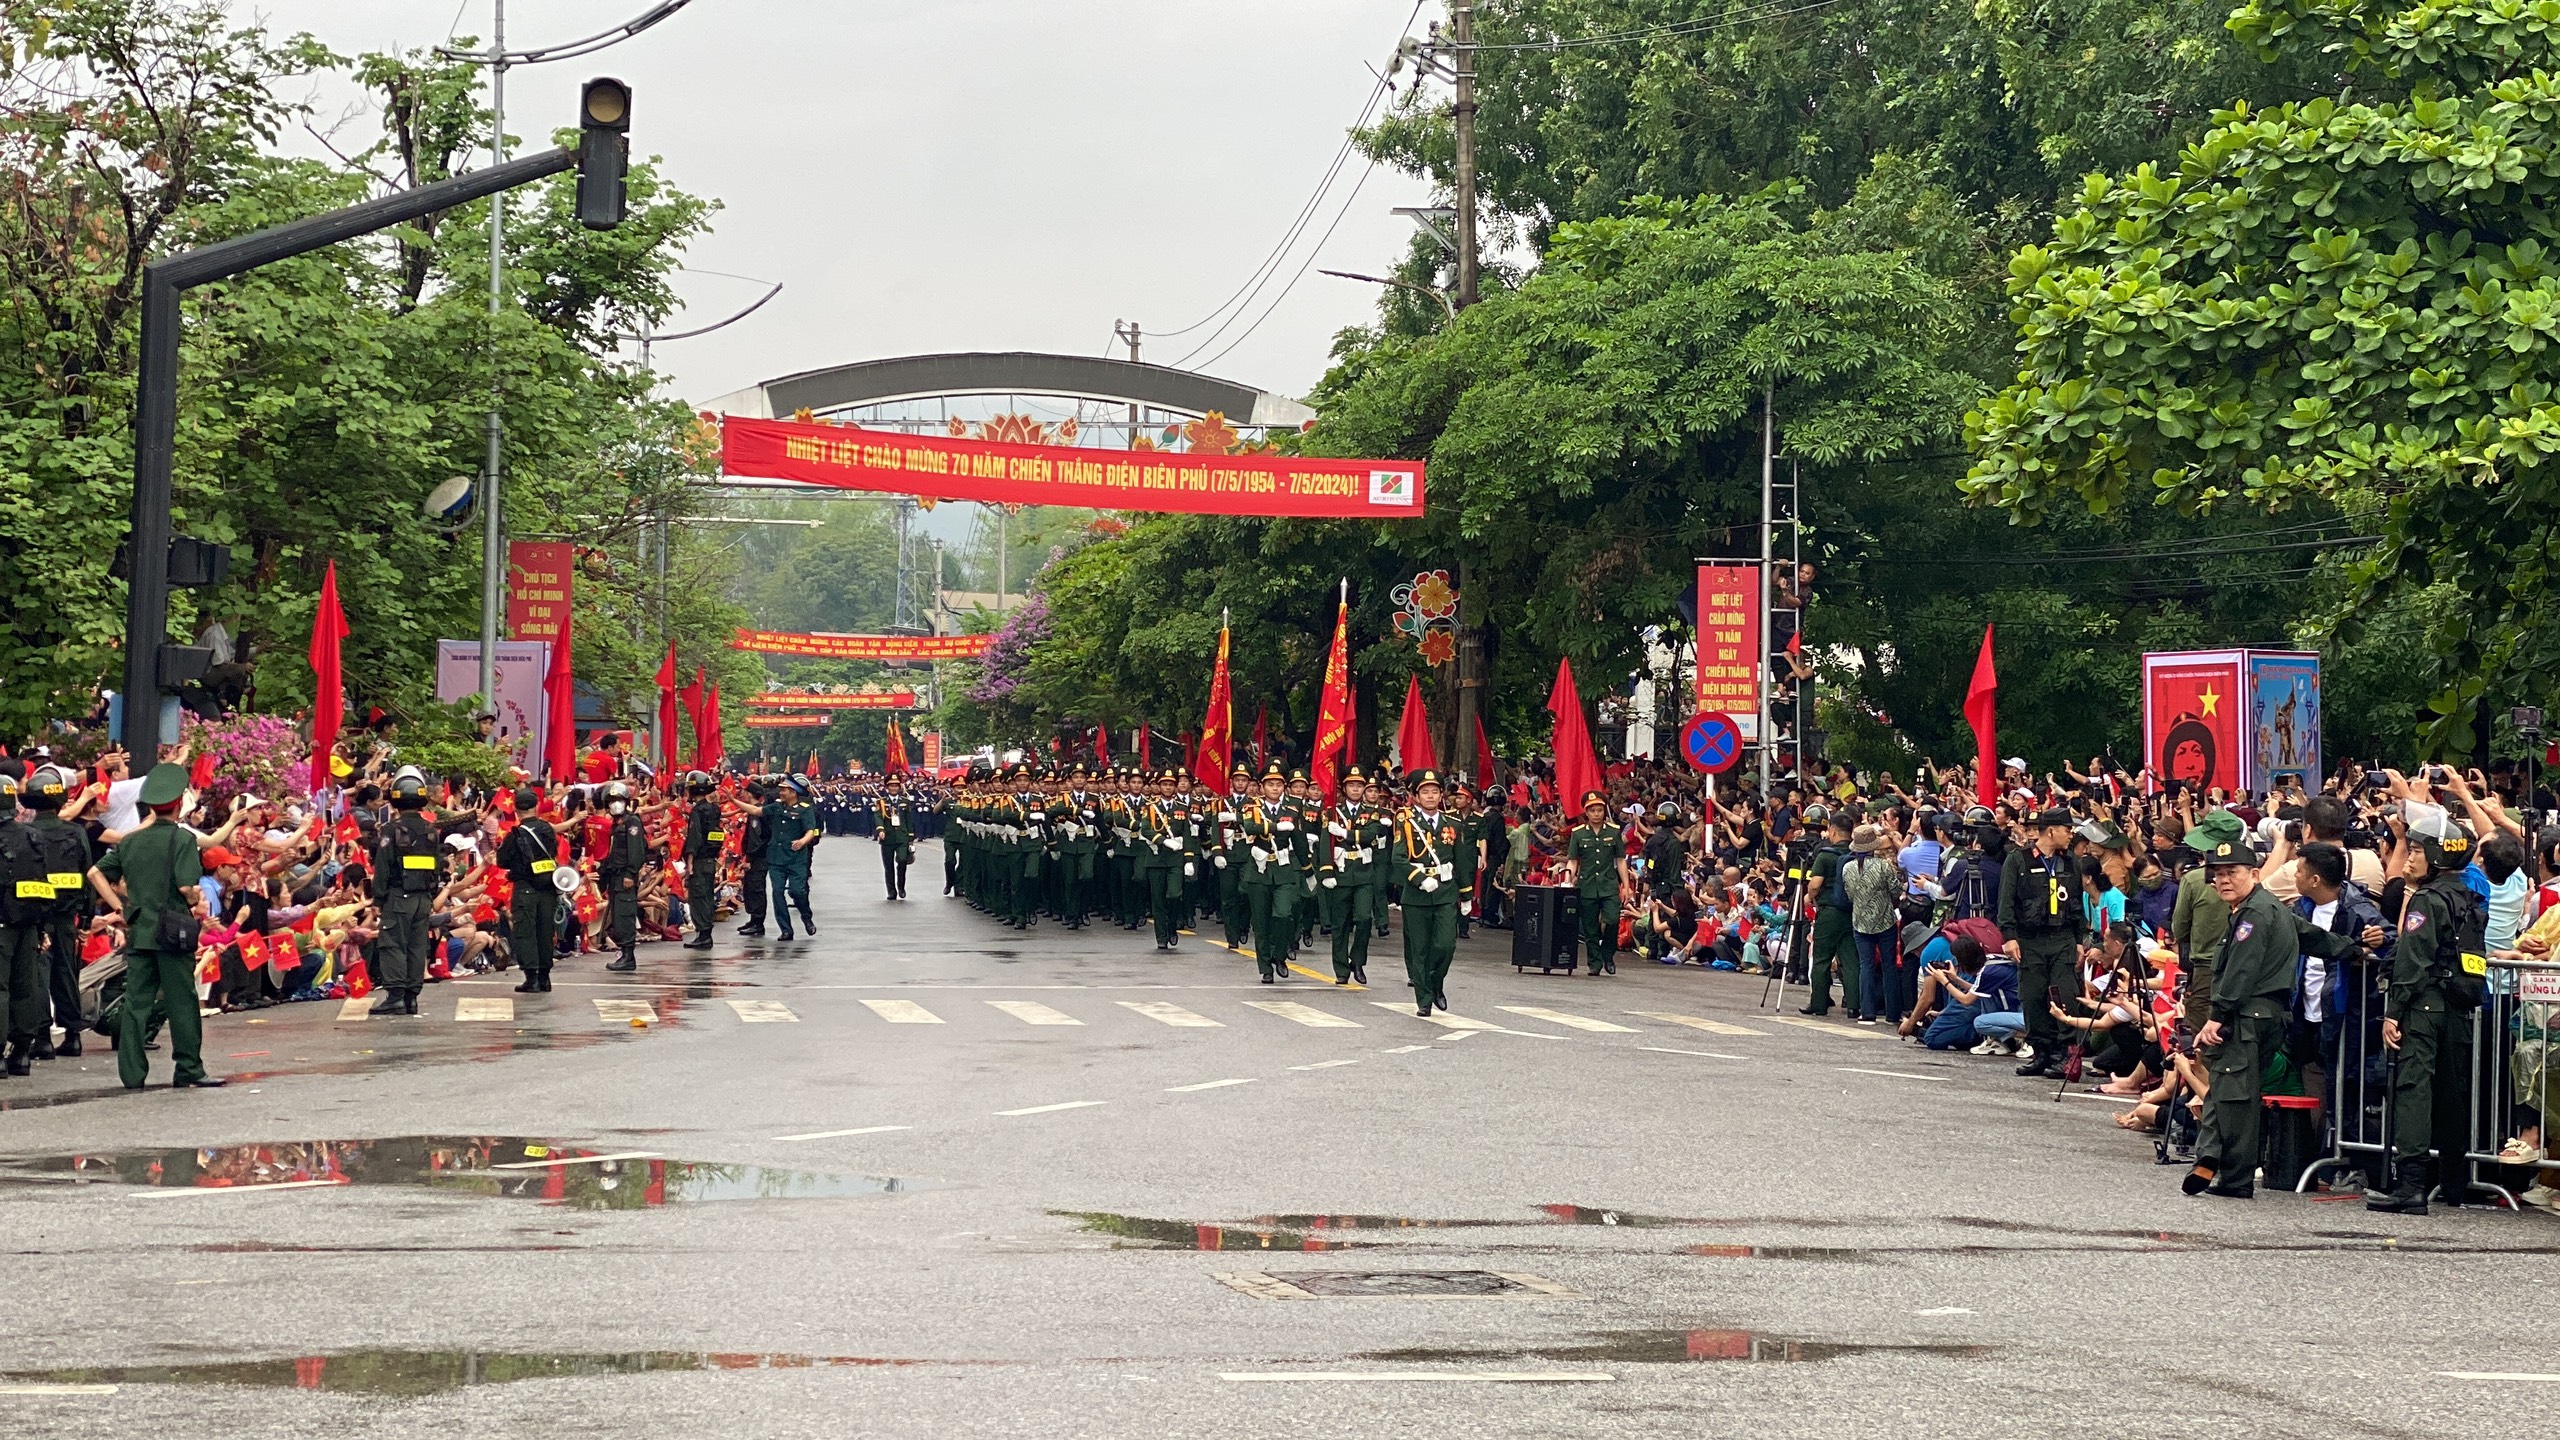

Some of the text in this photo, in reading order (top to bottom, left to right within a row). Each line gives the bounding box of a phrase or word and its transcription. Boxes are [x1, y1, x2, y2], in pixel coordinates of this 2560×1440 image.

[786, 435, 827, 464] NHIỆT
[831, 439, 860, 468] LIỆT
[864, 443, 900, 470] CHÀO
[905, 445, 948, 474] MỪNG
[952, 453, 969, 476] 70
[972, 451, 1006, 479] NĂM
[1009, 454, 1052, 482] CHIẾN
[1057, 456, 1103, 485] THẮNG
[1106, 460, 1139, 490] ĐIỆN
[1143, 462, 1176, 489] BIÊN
[1180, 463, 1208, 491] PHỦ
[1211, 469, 1276, 493] (7/5/1954
[1289, 472, 1359, 497] 7/5/2024)!
[524, 570, 558, 586] CHỦ TỊCH
[543, 590, 563, 601] MINH
[1711, 591, 1743, 609] NHIỆT LIỆT
[1709, 610, 1745, 625] CHÀO MỪNG
[521, 620, 558, 635] SỐNG MÃI
[1715, 629, 1742, 643] 70 NĂM
[1718, 646, 1738, 660] NGÀY
[1705, 662, 1750, 678] CHIẾN THẮNG
[1702, 680, 1753, 697] ĐIỆN BIÊN PHỦ
[52, 876, 77, 885] SCĐ
[2467, 957, 2486, 971] CS
